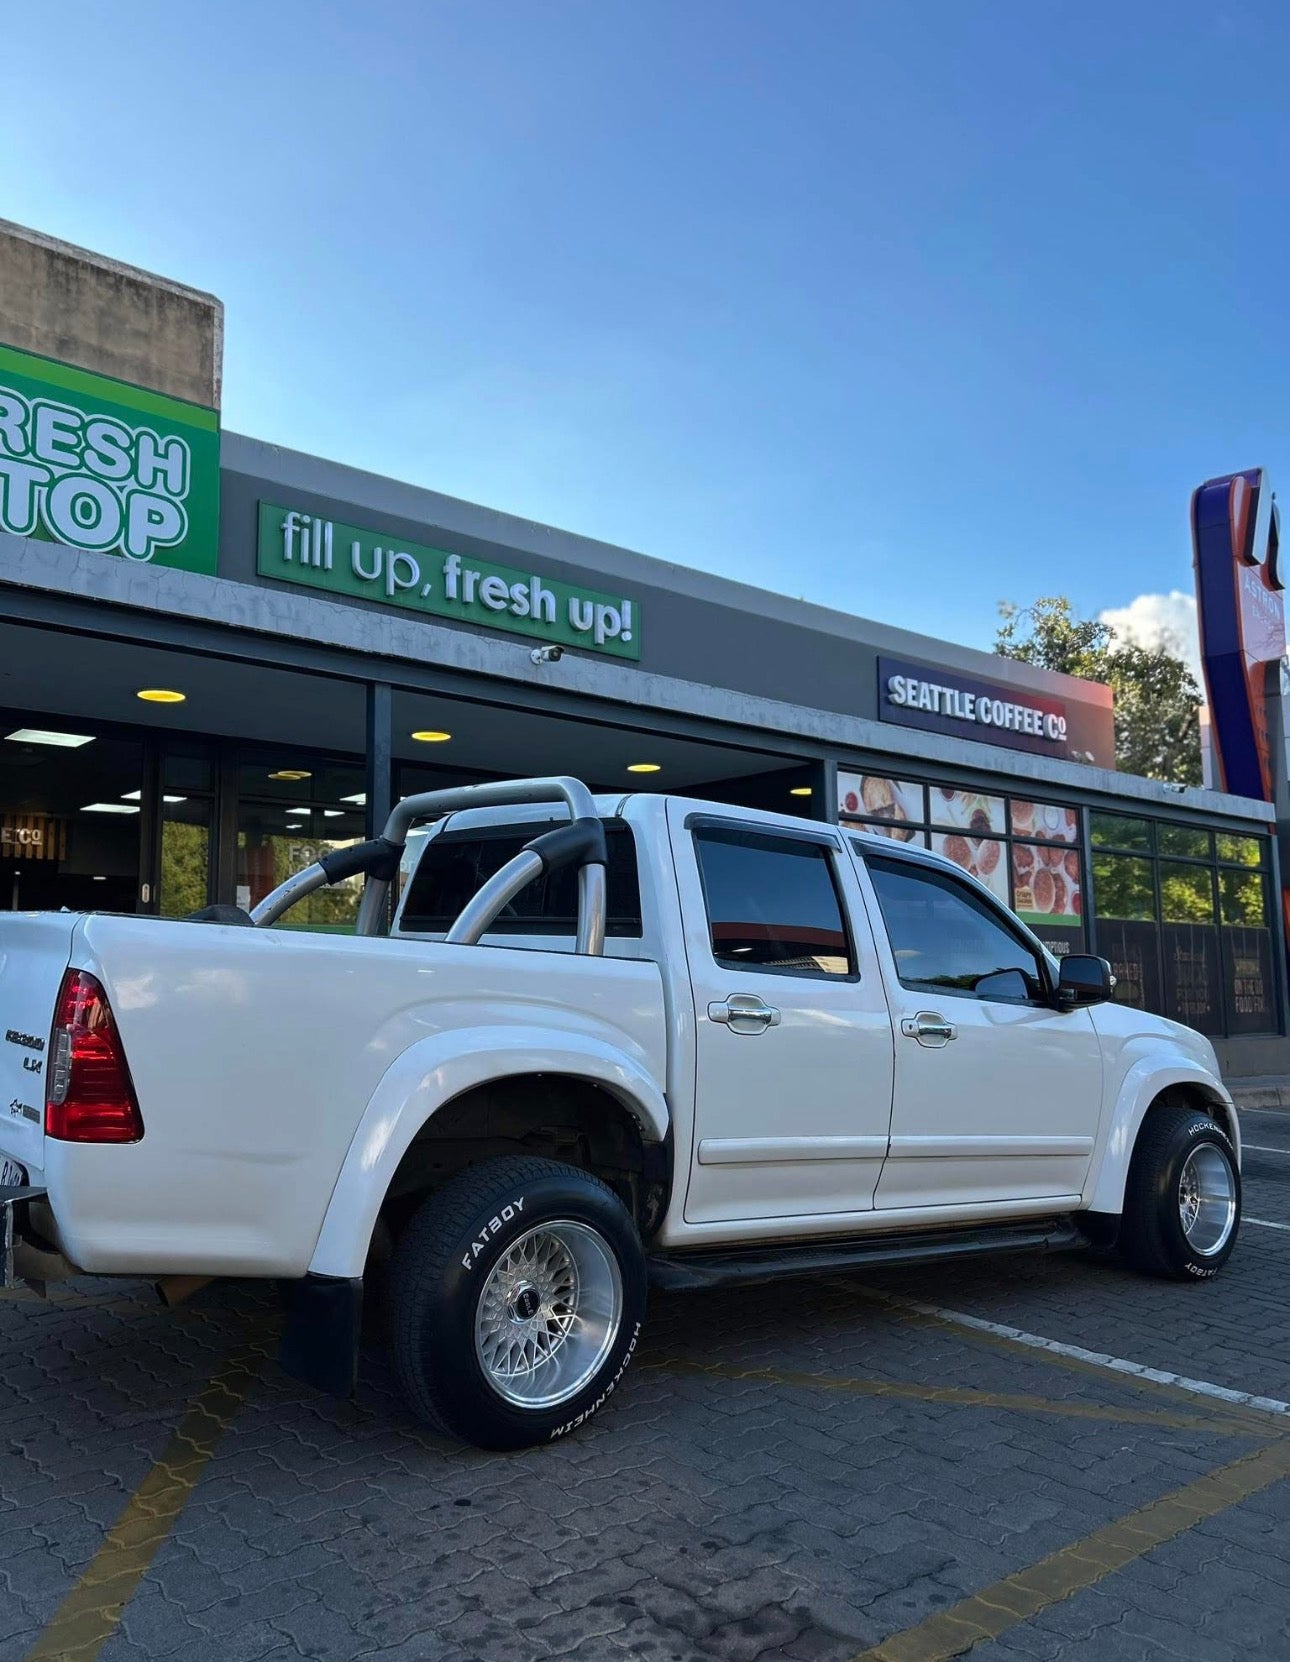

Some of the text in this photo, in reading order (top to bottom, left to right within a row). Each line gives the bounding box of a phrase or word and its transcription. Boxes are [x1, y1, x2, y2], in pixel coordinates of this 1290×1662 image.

[281, 511, 632, 645] fill up, fresh up!
[1244, 575, 1280, 620] ASTRON
[888, 675, 976, 721] SEATTLE
[975, 696, 1043, 736] COFFEE
[462, 1196, 525, 1270] FATBOY
[550, 1322, 641, 1438] HOCKENHEIM
